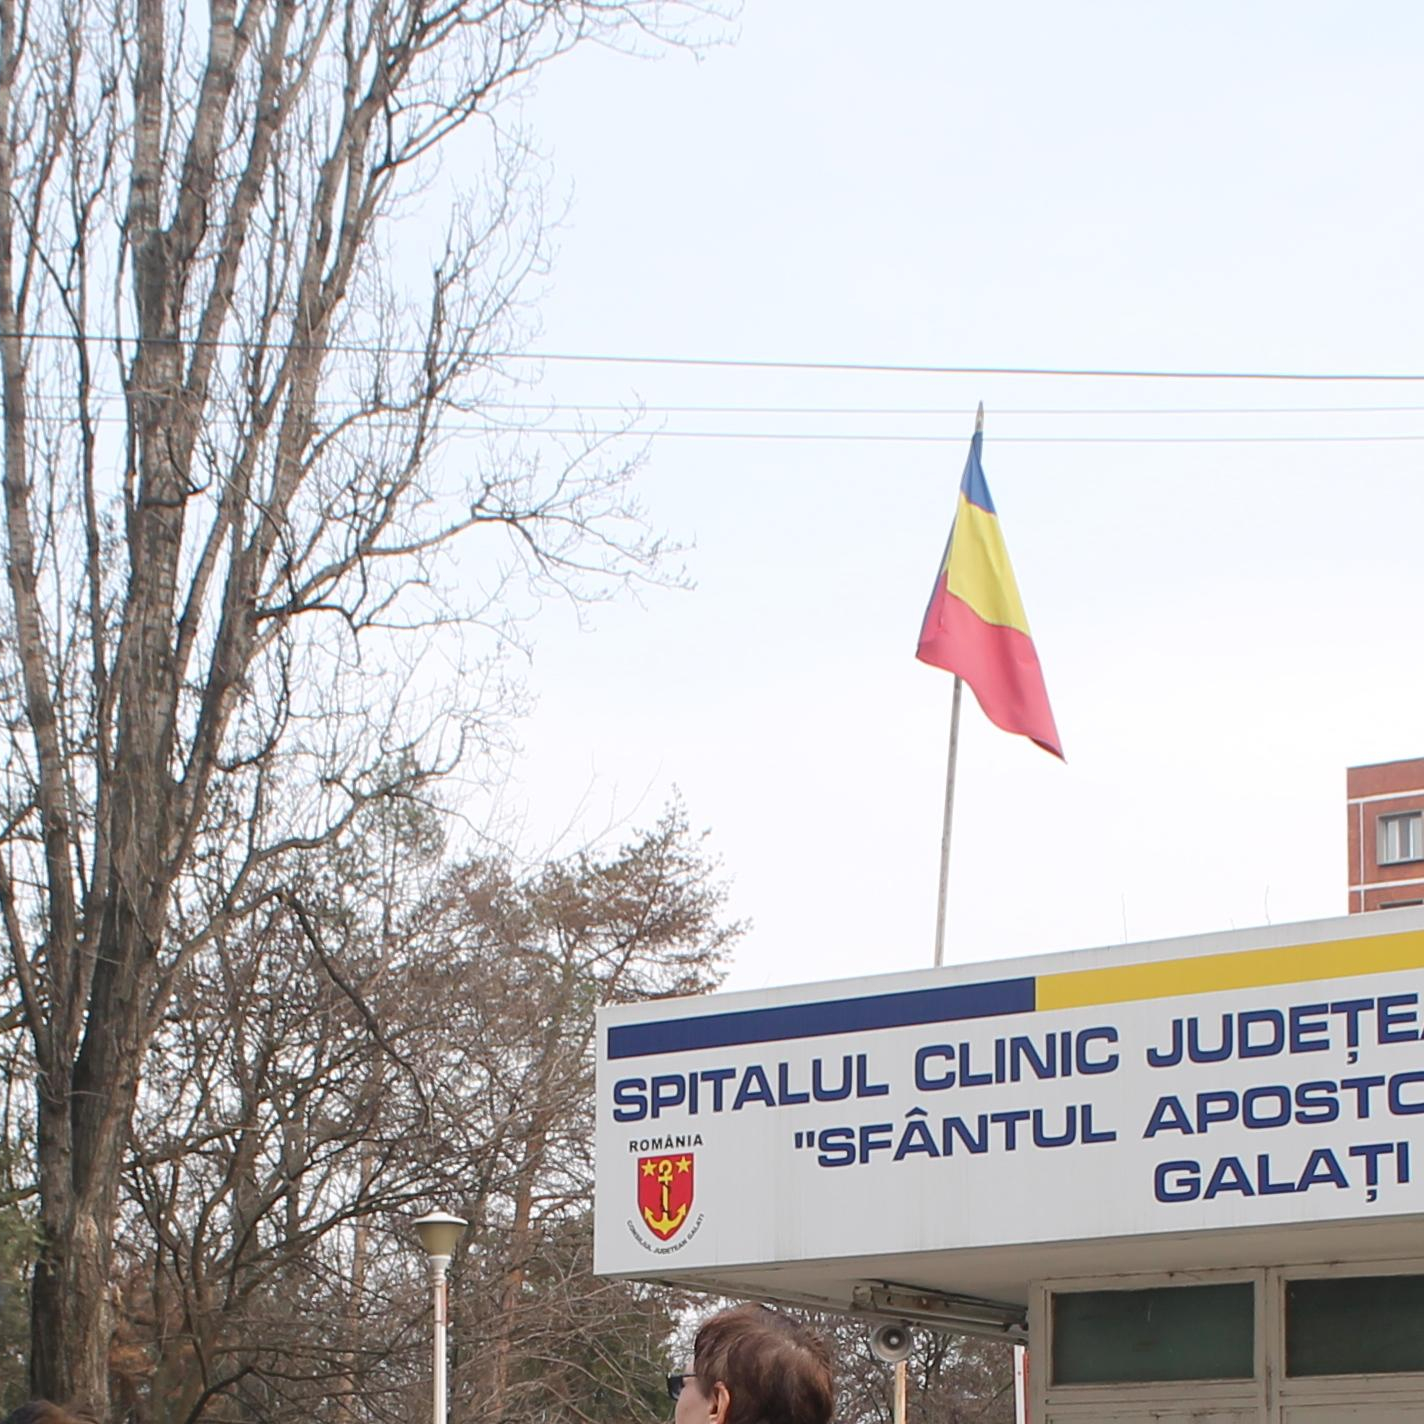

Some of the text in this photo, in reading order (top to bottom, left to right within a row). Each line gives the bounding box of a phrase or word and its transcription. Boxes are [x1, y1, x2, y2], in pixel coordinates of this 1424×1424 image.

[612, 1053, 890, 1123] SPITALUL
[915, 1026, 1120, 1091] CLINIC
[629, 1134, 704, 1152] ROMÂNIA
[794, 1104, 1117, 1167] "SFÂNTUL
[1154, 1141, 1410, 1203] GALAȚI
